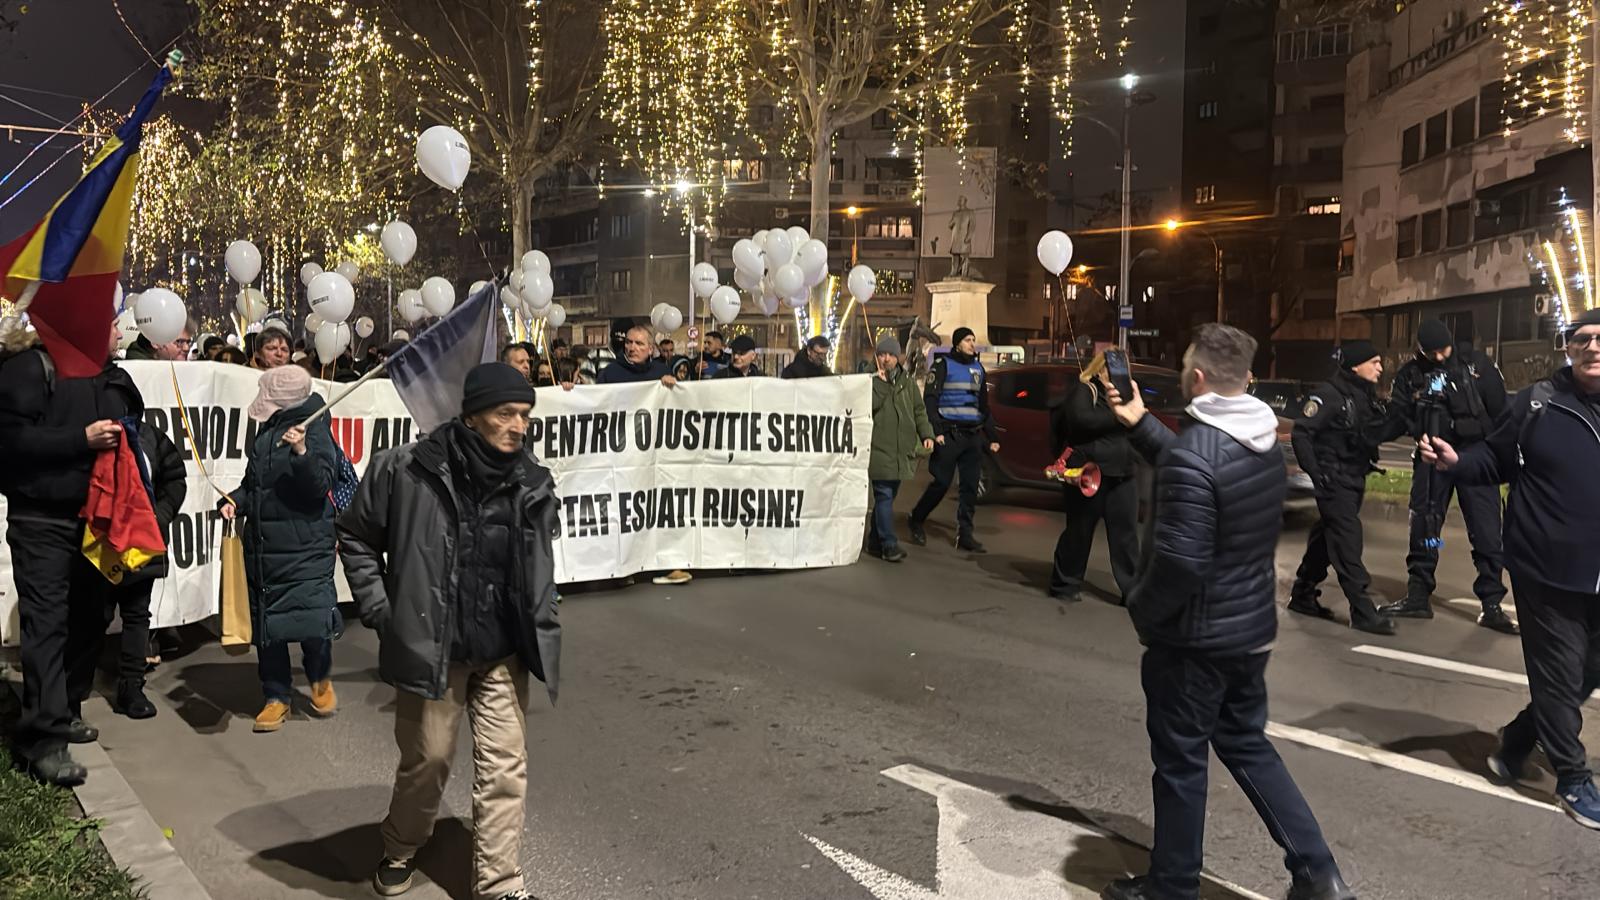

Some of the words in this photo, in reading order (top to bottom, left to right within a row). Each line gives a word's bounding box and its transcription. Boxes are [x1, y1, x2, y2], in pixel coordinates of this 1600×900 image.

[526, 411, 626, 459] PENTRU
[634, 408, 651, 451] O
[654, 409, 762, 463] JUSTIȚIE
[767, 409, 858, 458] SERVILĂ,
[618, 487, 697, 534] ESUAT!
[702, 488, 804, 541] RUȘINE!
